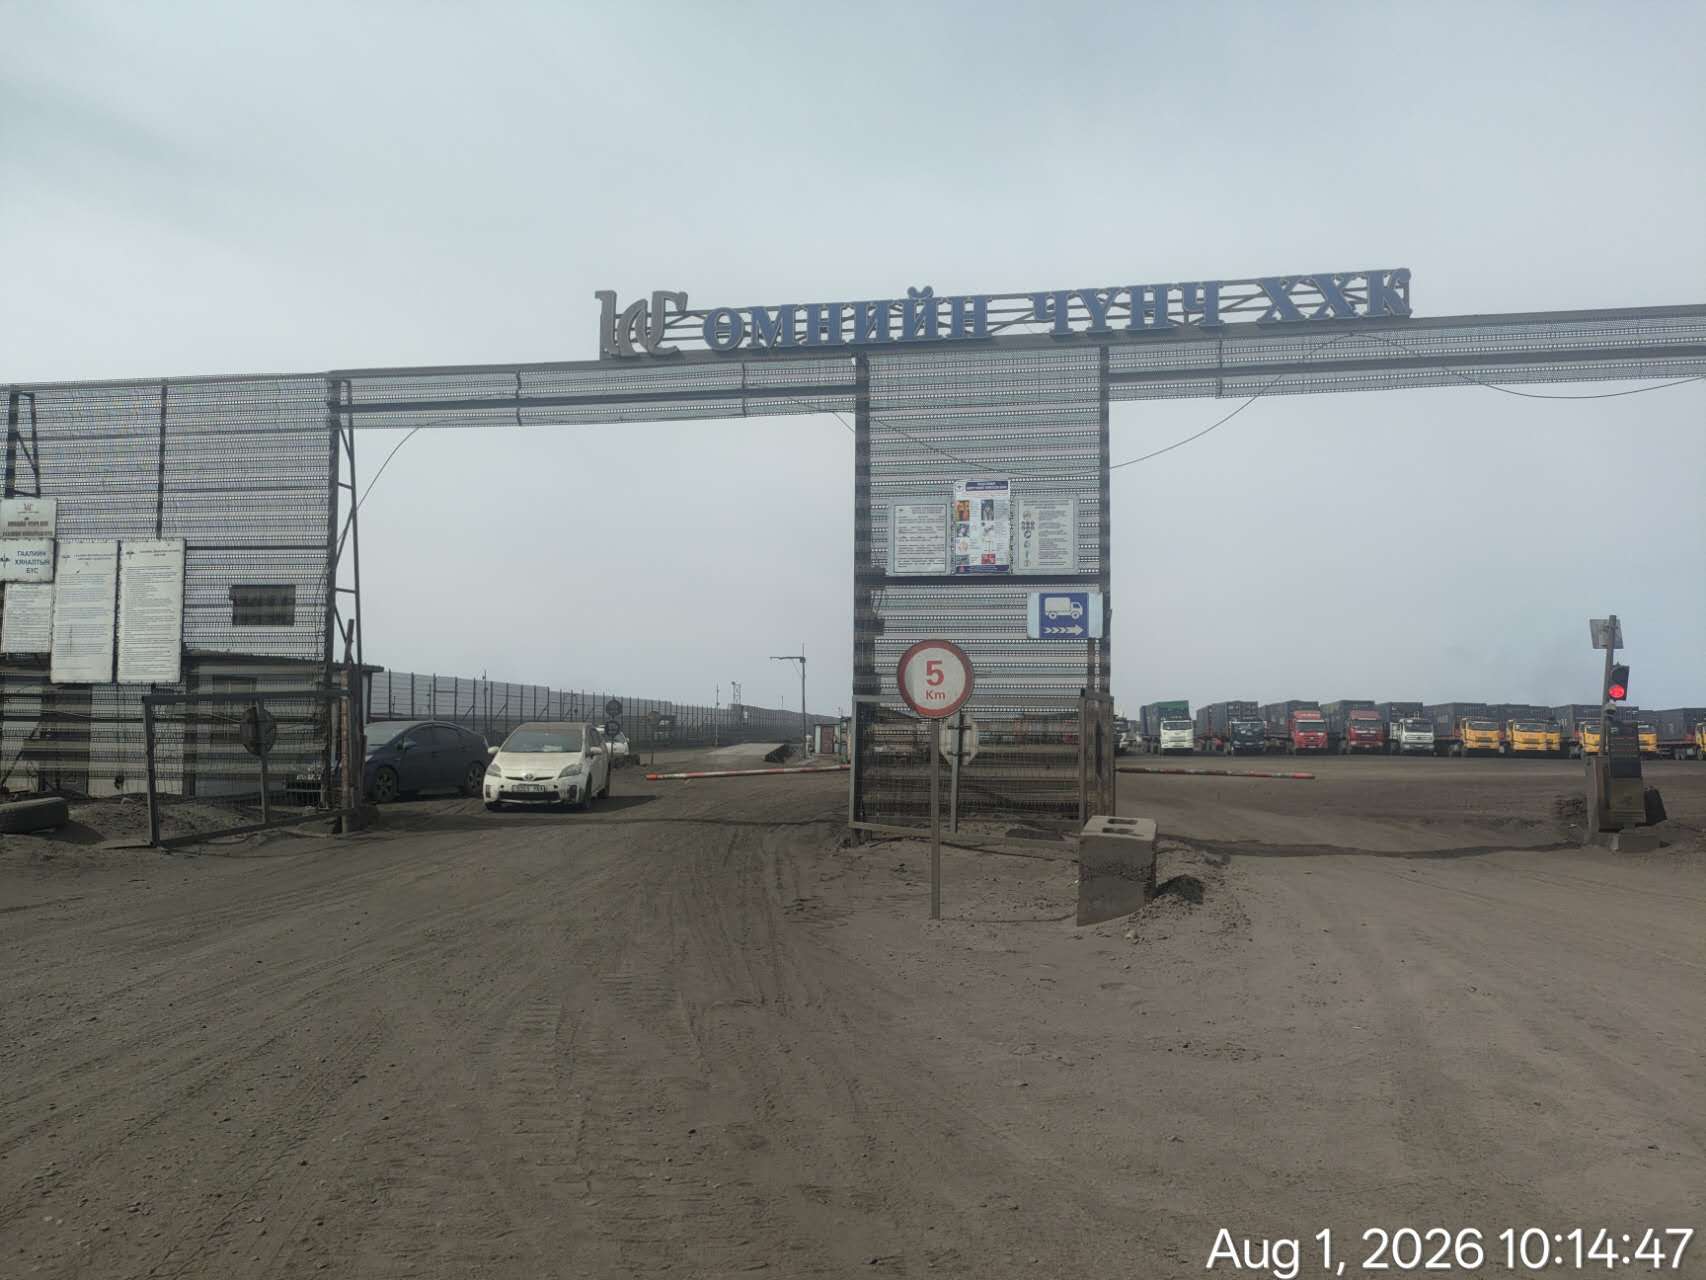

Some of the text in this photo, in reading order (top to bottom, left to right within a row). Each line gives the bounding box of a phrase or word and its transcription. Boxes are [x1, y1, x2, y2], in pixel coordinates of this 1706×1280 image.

[702, 285, 992, 351] ӨМНИЙН
[1256, 268, 1411, 323] ХХК
[925, 660, 944, 686] 5
[925, 690, 946, 701] Km
